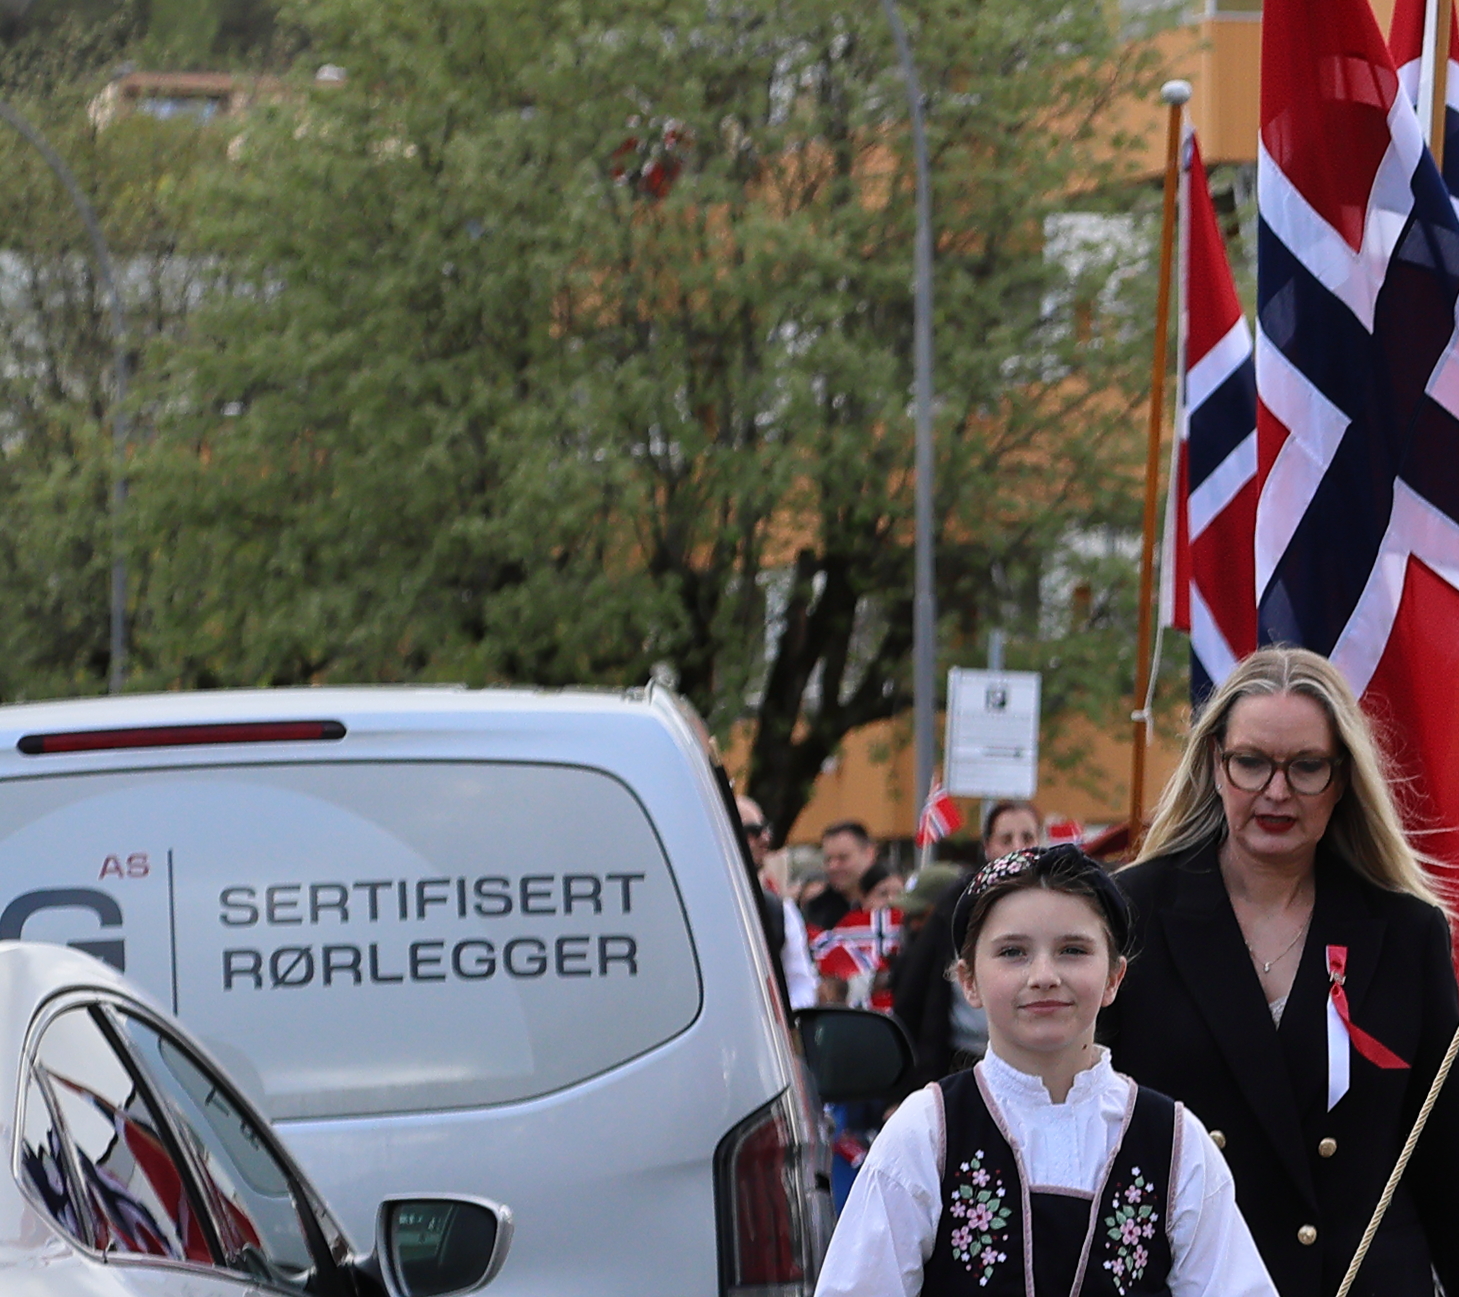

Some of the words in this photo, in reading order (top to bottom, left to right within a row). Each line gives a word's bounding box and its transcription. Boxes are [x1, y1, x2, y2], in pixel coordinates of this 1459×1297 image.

[98, 853, 151, 880] AS
[218, 871, 646, 929] SERTIFISERT
[222, 934, 639, 991] RØRLEGGER
